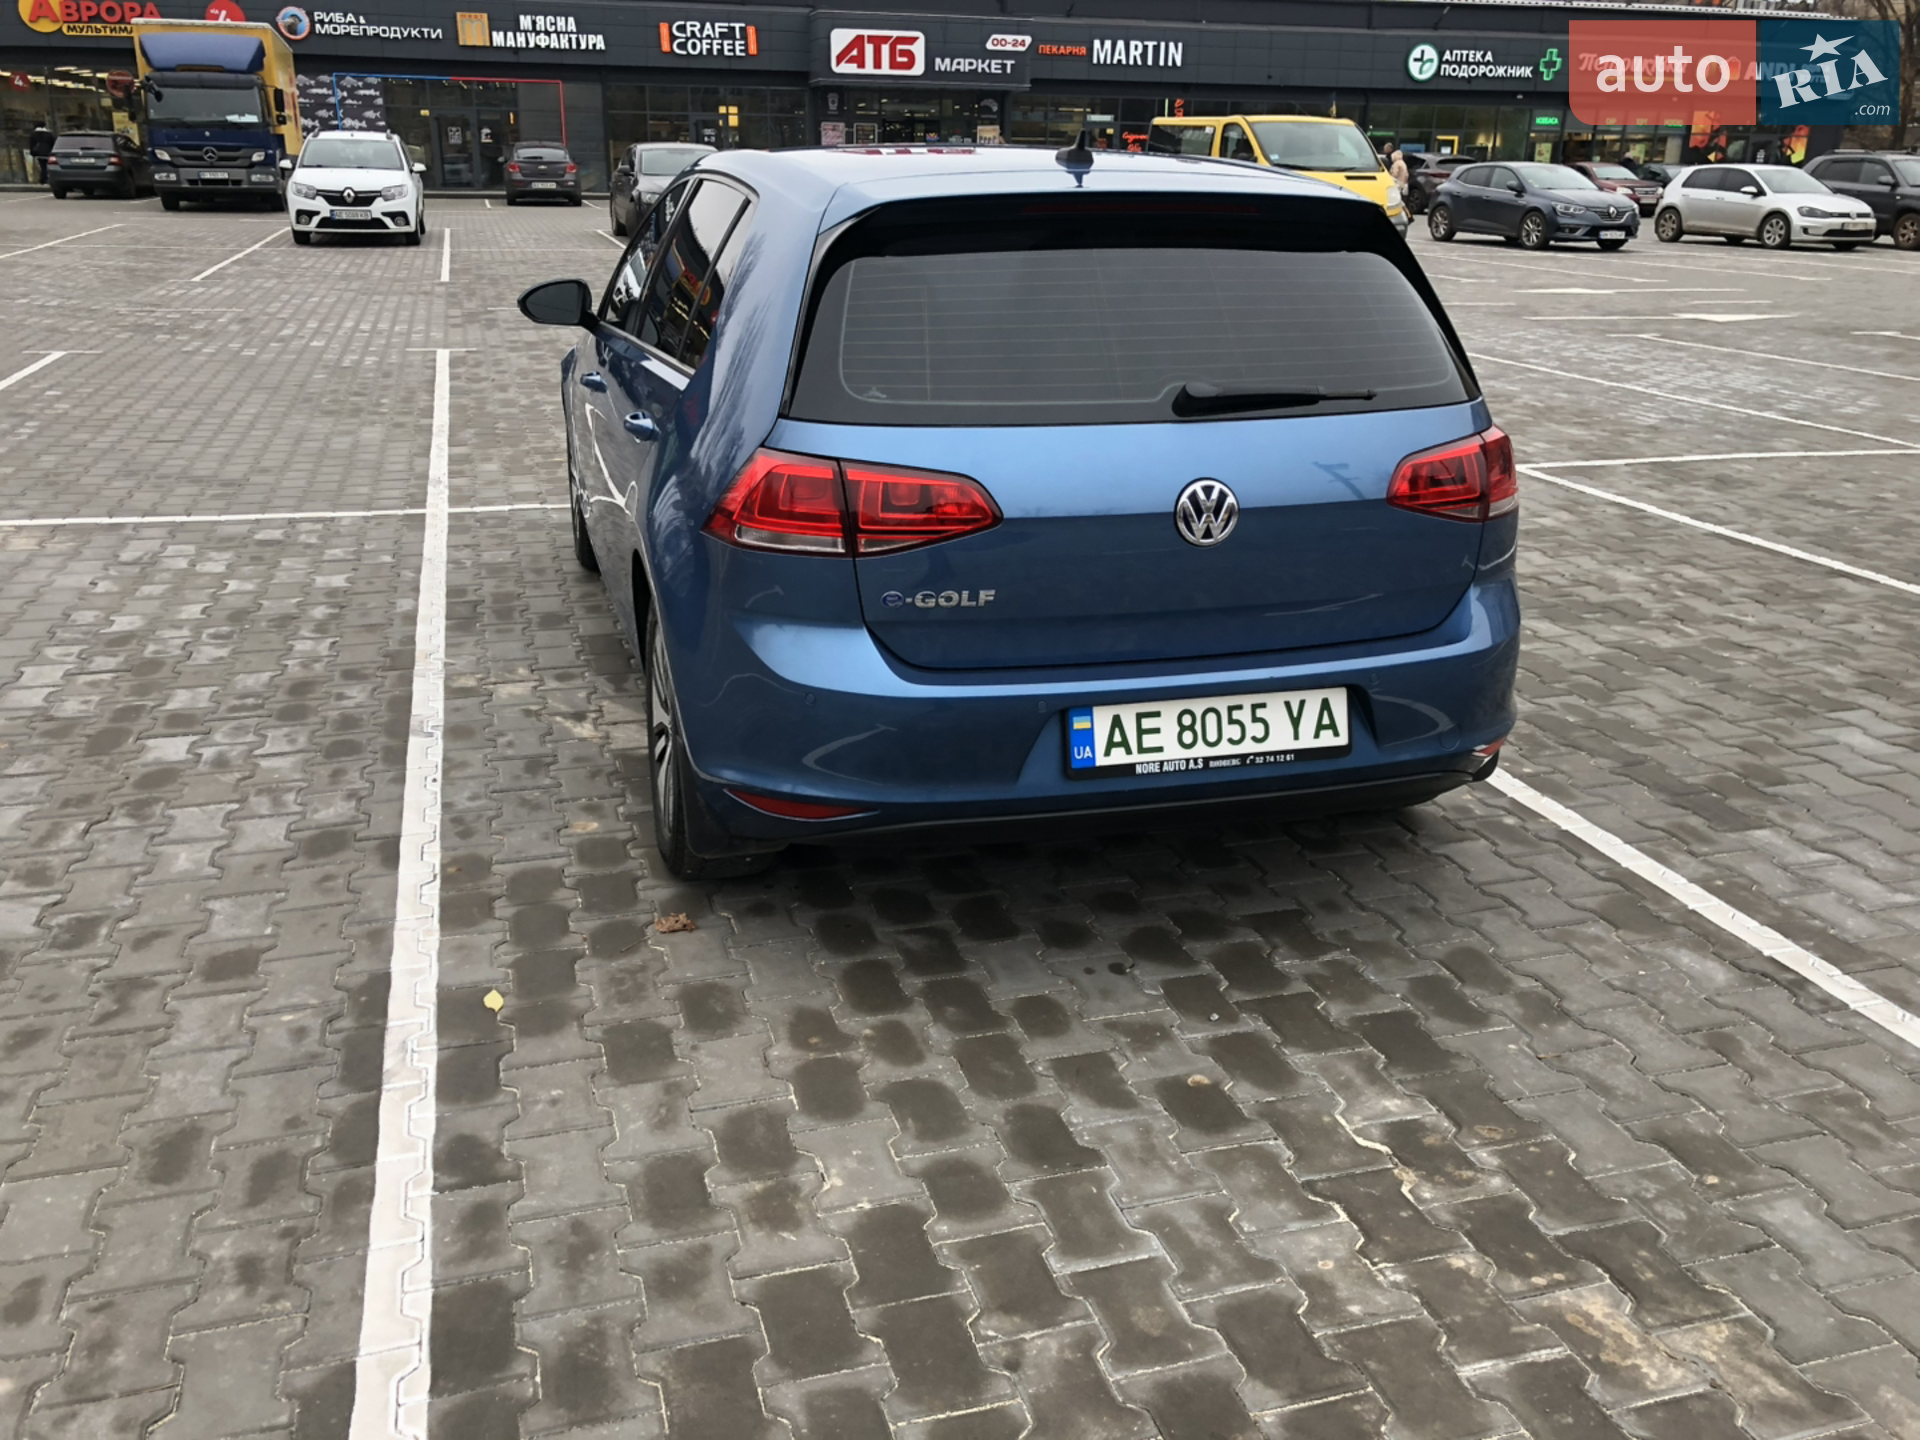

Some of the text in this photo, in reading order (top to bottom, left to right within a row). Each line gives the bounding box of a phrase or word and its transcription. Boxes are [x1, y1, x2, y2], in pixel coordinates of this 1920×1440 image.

[29, 0, 162, 23] АВРОРА
[314, 12, 357, 24] РИБА
[315, 23, 443, 39] МОРЕПРОДУКТИ
[519, 14, 577, 32] М'ЯСНА
[672, 21, 746, 39] CRAFT
[492, 31, 606, 50] МАНУФАКТУРА
[672, 38, 746, 56] COFFEE
[991, 38, 1026, 48] 00-24
[836, 34, 921, 70] АТБ
[1038, 39, 1183, 67] ПЕКАРНЯ MARTIN
[1442, 50, 1493, 62] АПТЕКА
[935, 57, 1015, 74] МАРКЕТ
[1440, 64, 1533, 78] ПОДОРОЖНИК
[1103, 697, 1340, 757] AE 8055 YA
[1073, 746, 1093, 760] UA
[1135, 762, 1161, 775] NORE
[1162, 760, 1186, 773] AUTO
[1188, 758, 1204, 770] A.S
[1276, 754, 1285, 762] 12
